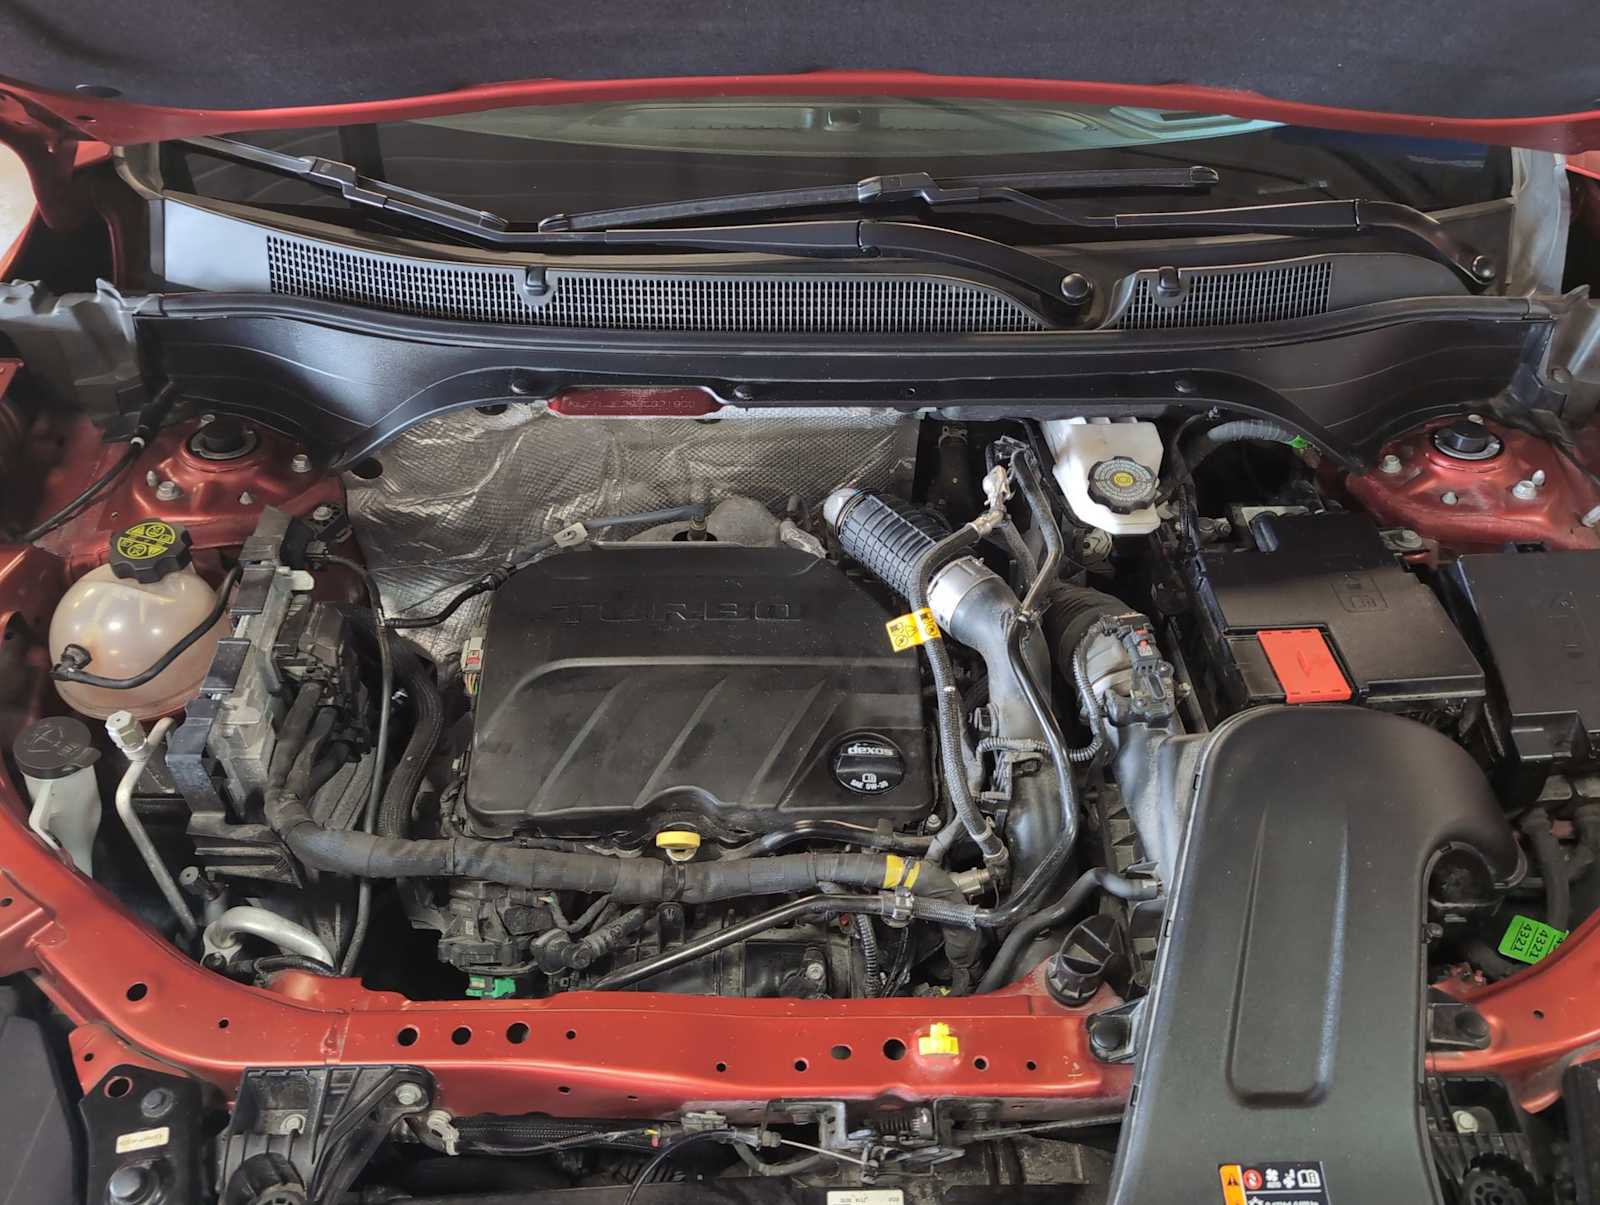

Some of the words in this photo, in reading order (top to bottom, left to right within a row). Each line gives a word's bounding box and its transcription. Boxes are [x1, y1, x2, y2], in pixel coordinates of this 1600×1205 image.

[847, 743, 894, 756] dexos
[1512, 923, 1533, 952] 4321
[1529, 929, 1549, 958] 4321
